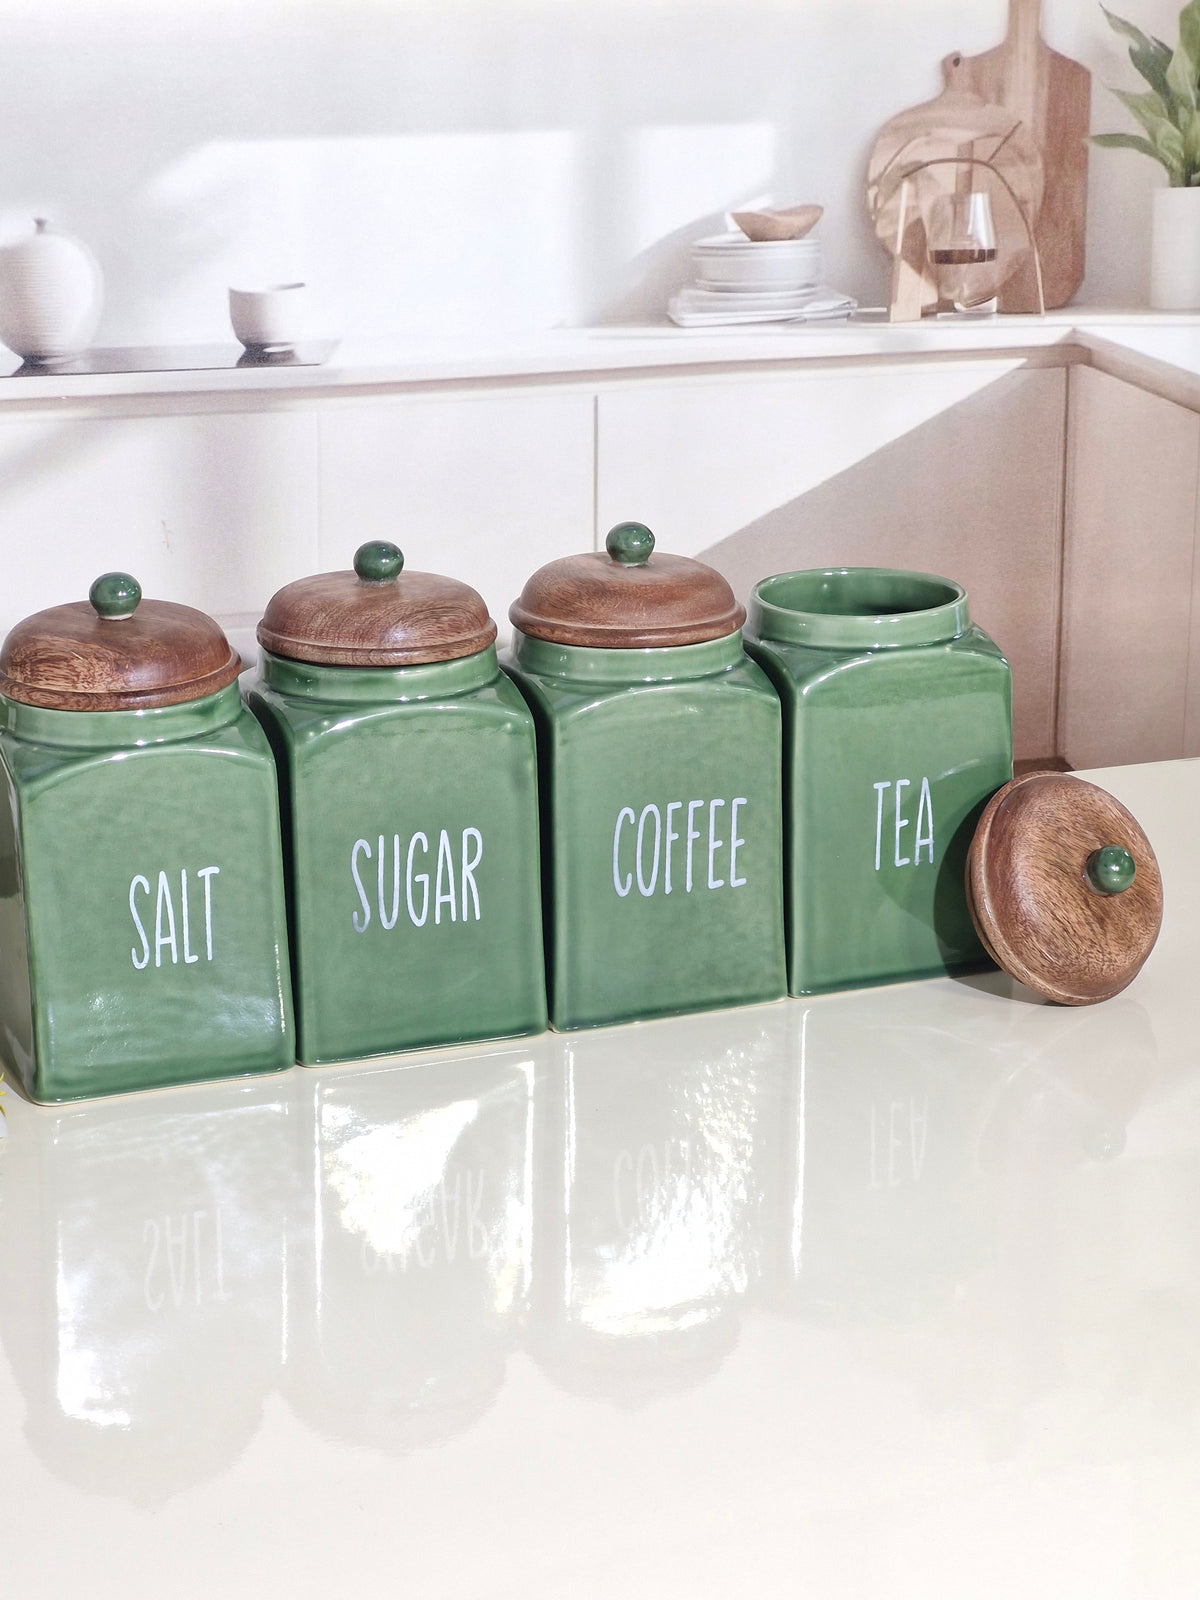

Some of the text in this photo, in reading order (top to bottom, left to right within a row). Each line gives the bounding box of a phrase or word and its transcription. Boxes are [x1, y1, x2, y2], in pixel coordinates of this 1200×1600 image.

[613, 797, 748, 897] COFFEE
[873, 776, 934, 871] TEA
[129, 865, 220, 970] SALT
[351, 826, 483, 933] SUGAR
